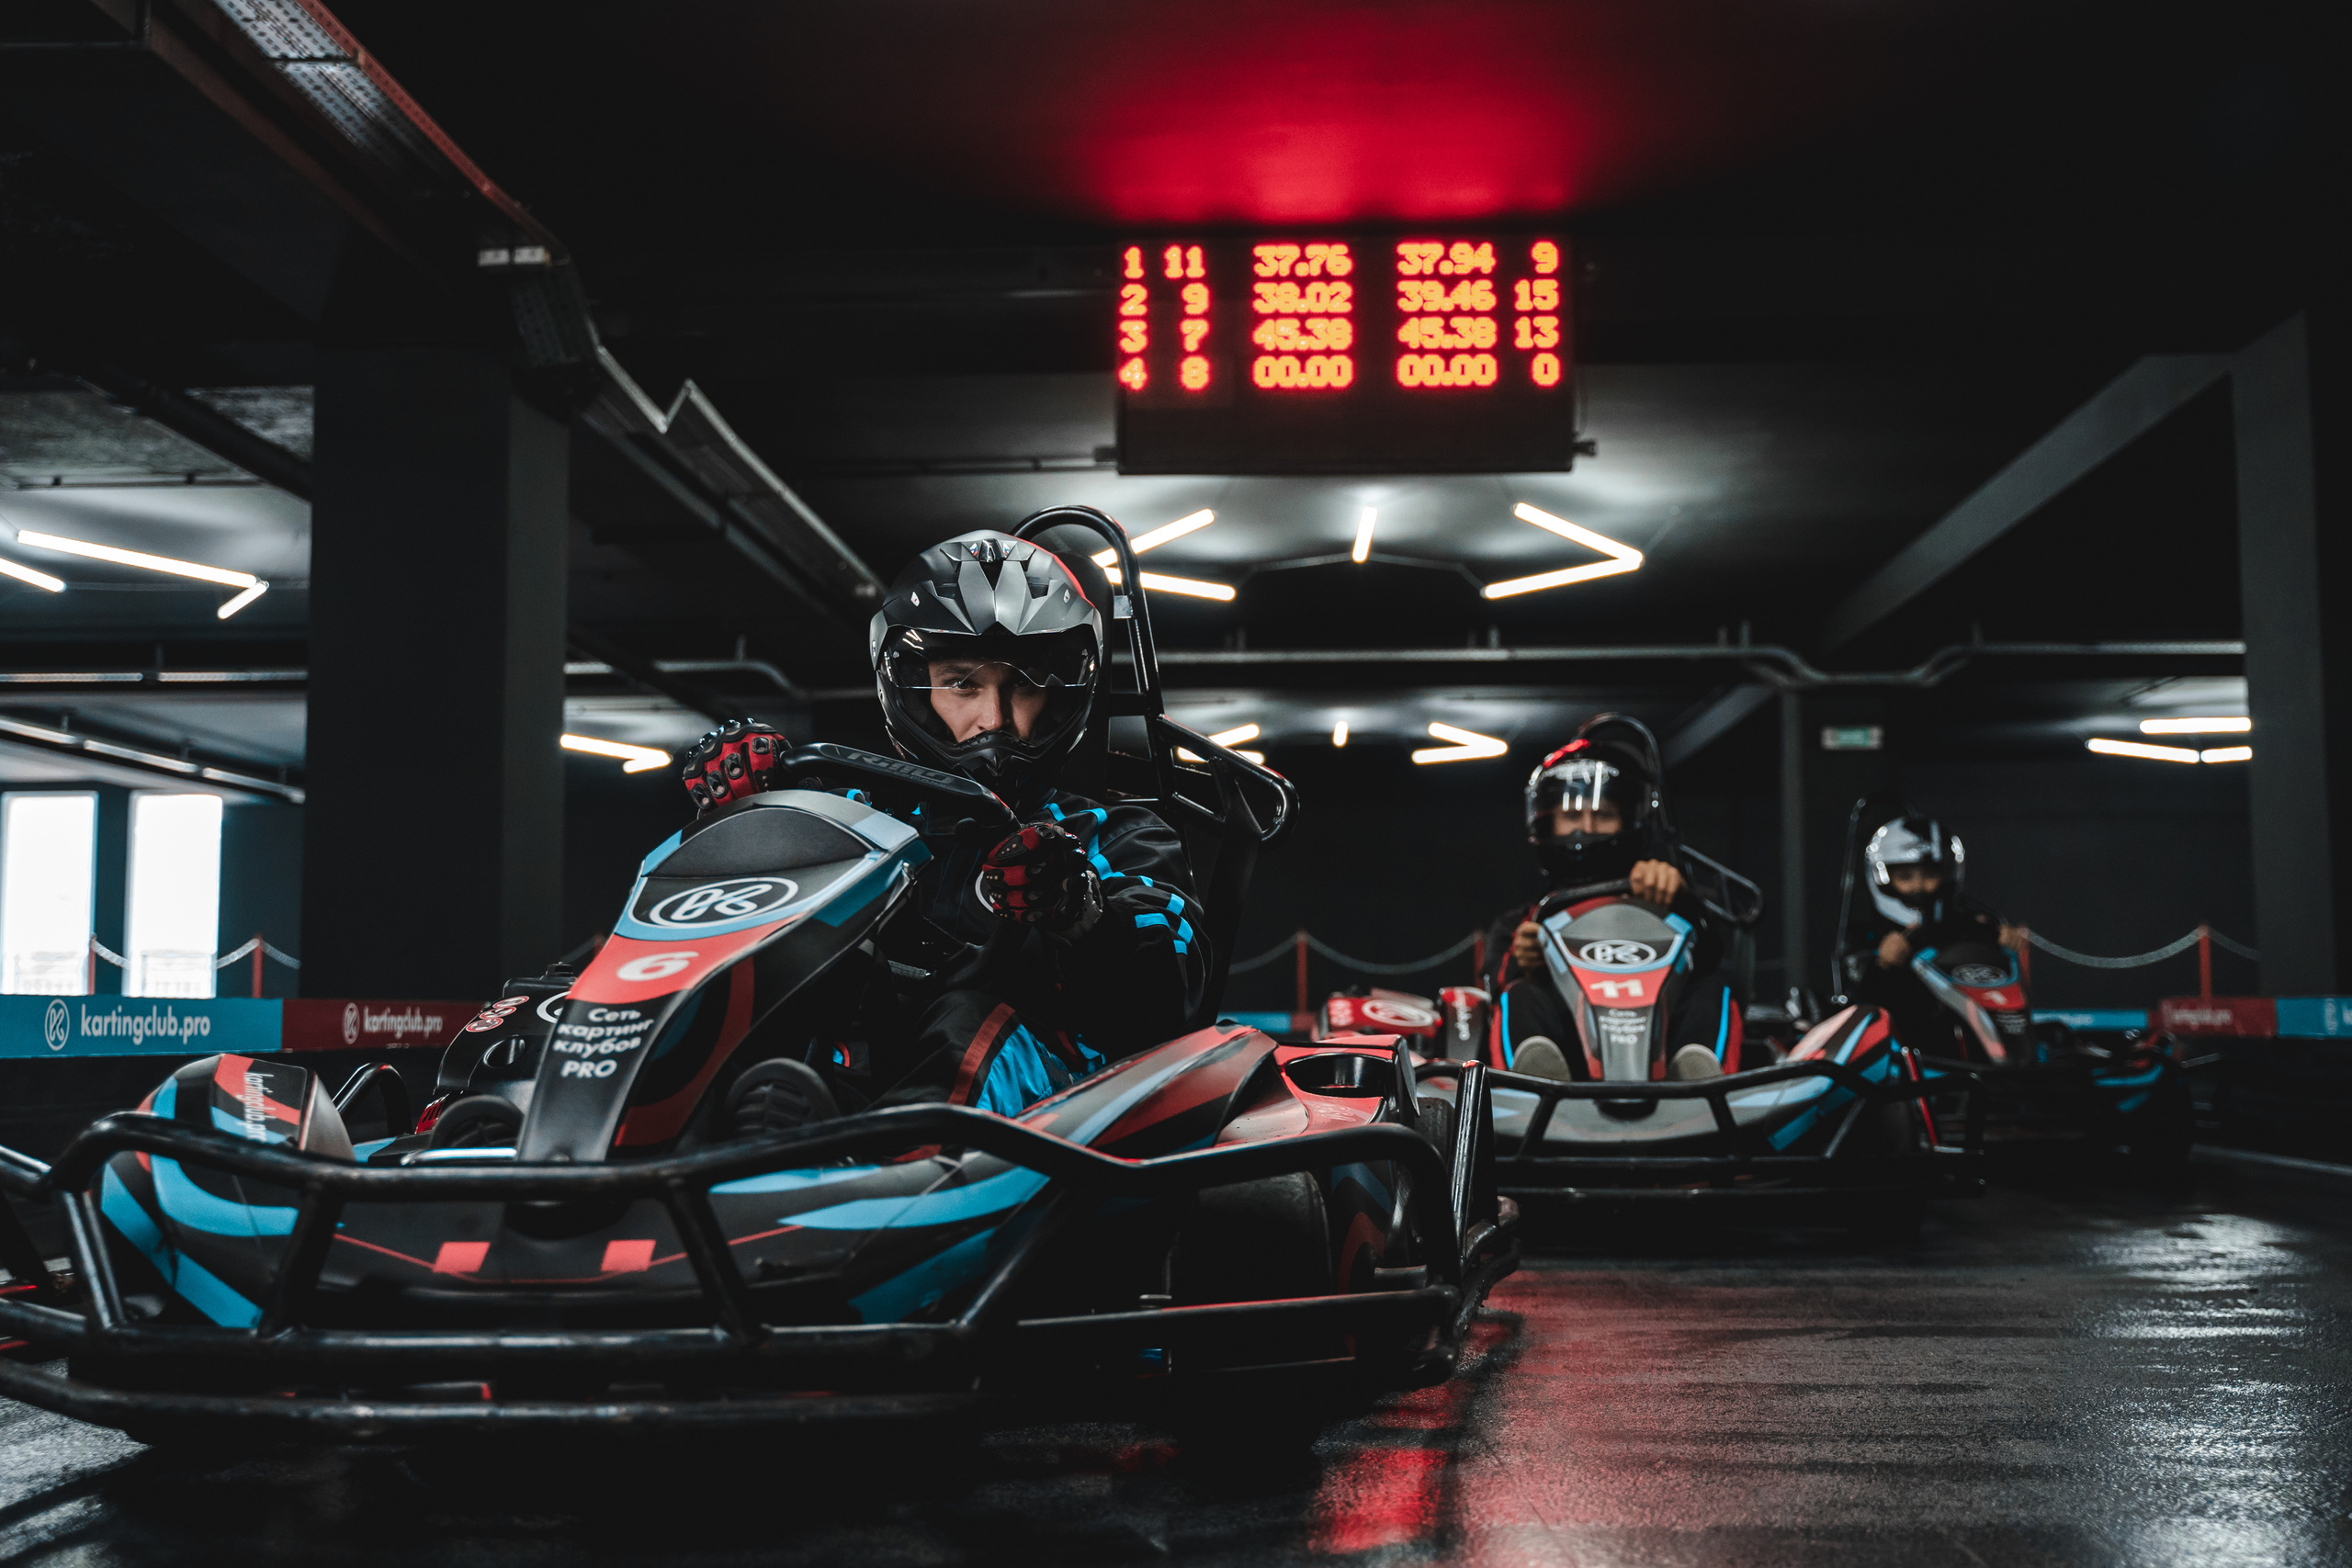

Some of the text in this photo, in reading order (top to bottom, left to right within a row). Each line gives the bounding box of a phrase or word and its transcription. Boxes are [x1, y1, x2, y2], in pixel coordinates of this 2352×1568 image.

[1125, 242, 1559, 278] 1 11 37.76 37.94 9
[1120, 279, 1559, 315] 2 9 38.02 39.46 15
[1120, 316, 1559, 353] 3 7 45.38 45.38 13
[1119, 353, 1559, 389] 4 8 00.00 00.00 0
[616, 951, 699, 982] 6
[1589, 979, 1645, 998] 11
[81, 1003, 211, 1045] kartingclub.pro
[556, 1018, 655, 1042] картинг
[588, 1007, 642, 1022] Сеть
[553, 1036, 641, 1059] клубов
[560, 1059, 618, 1078] PRO
